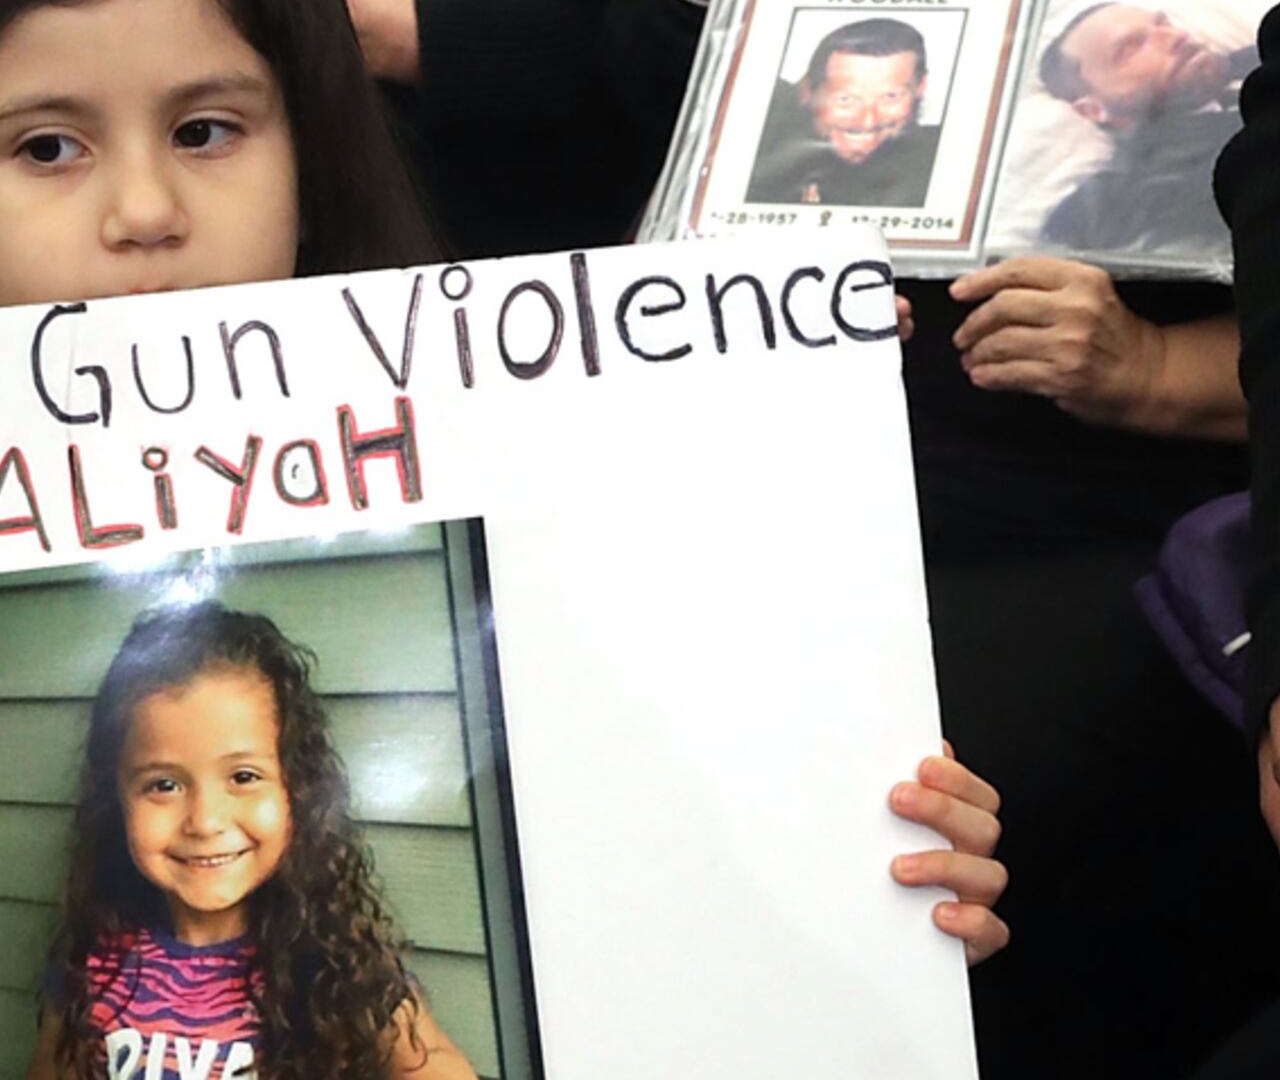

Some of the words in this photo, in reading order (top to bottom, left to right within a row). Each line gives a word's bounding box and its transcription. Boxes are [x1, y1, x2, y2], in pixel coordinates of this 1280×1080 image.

[711, 211, 797, 225] -28-1957
[30, 302, 290, 428] Gun
[341, 253, 902, 390] Violence
